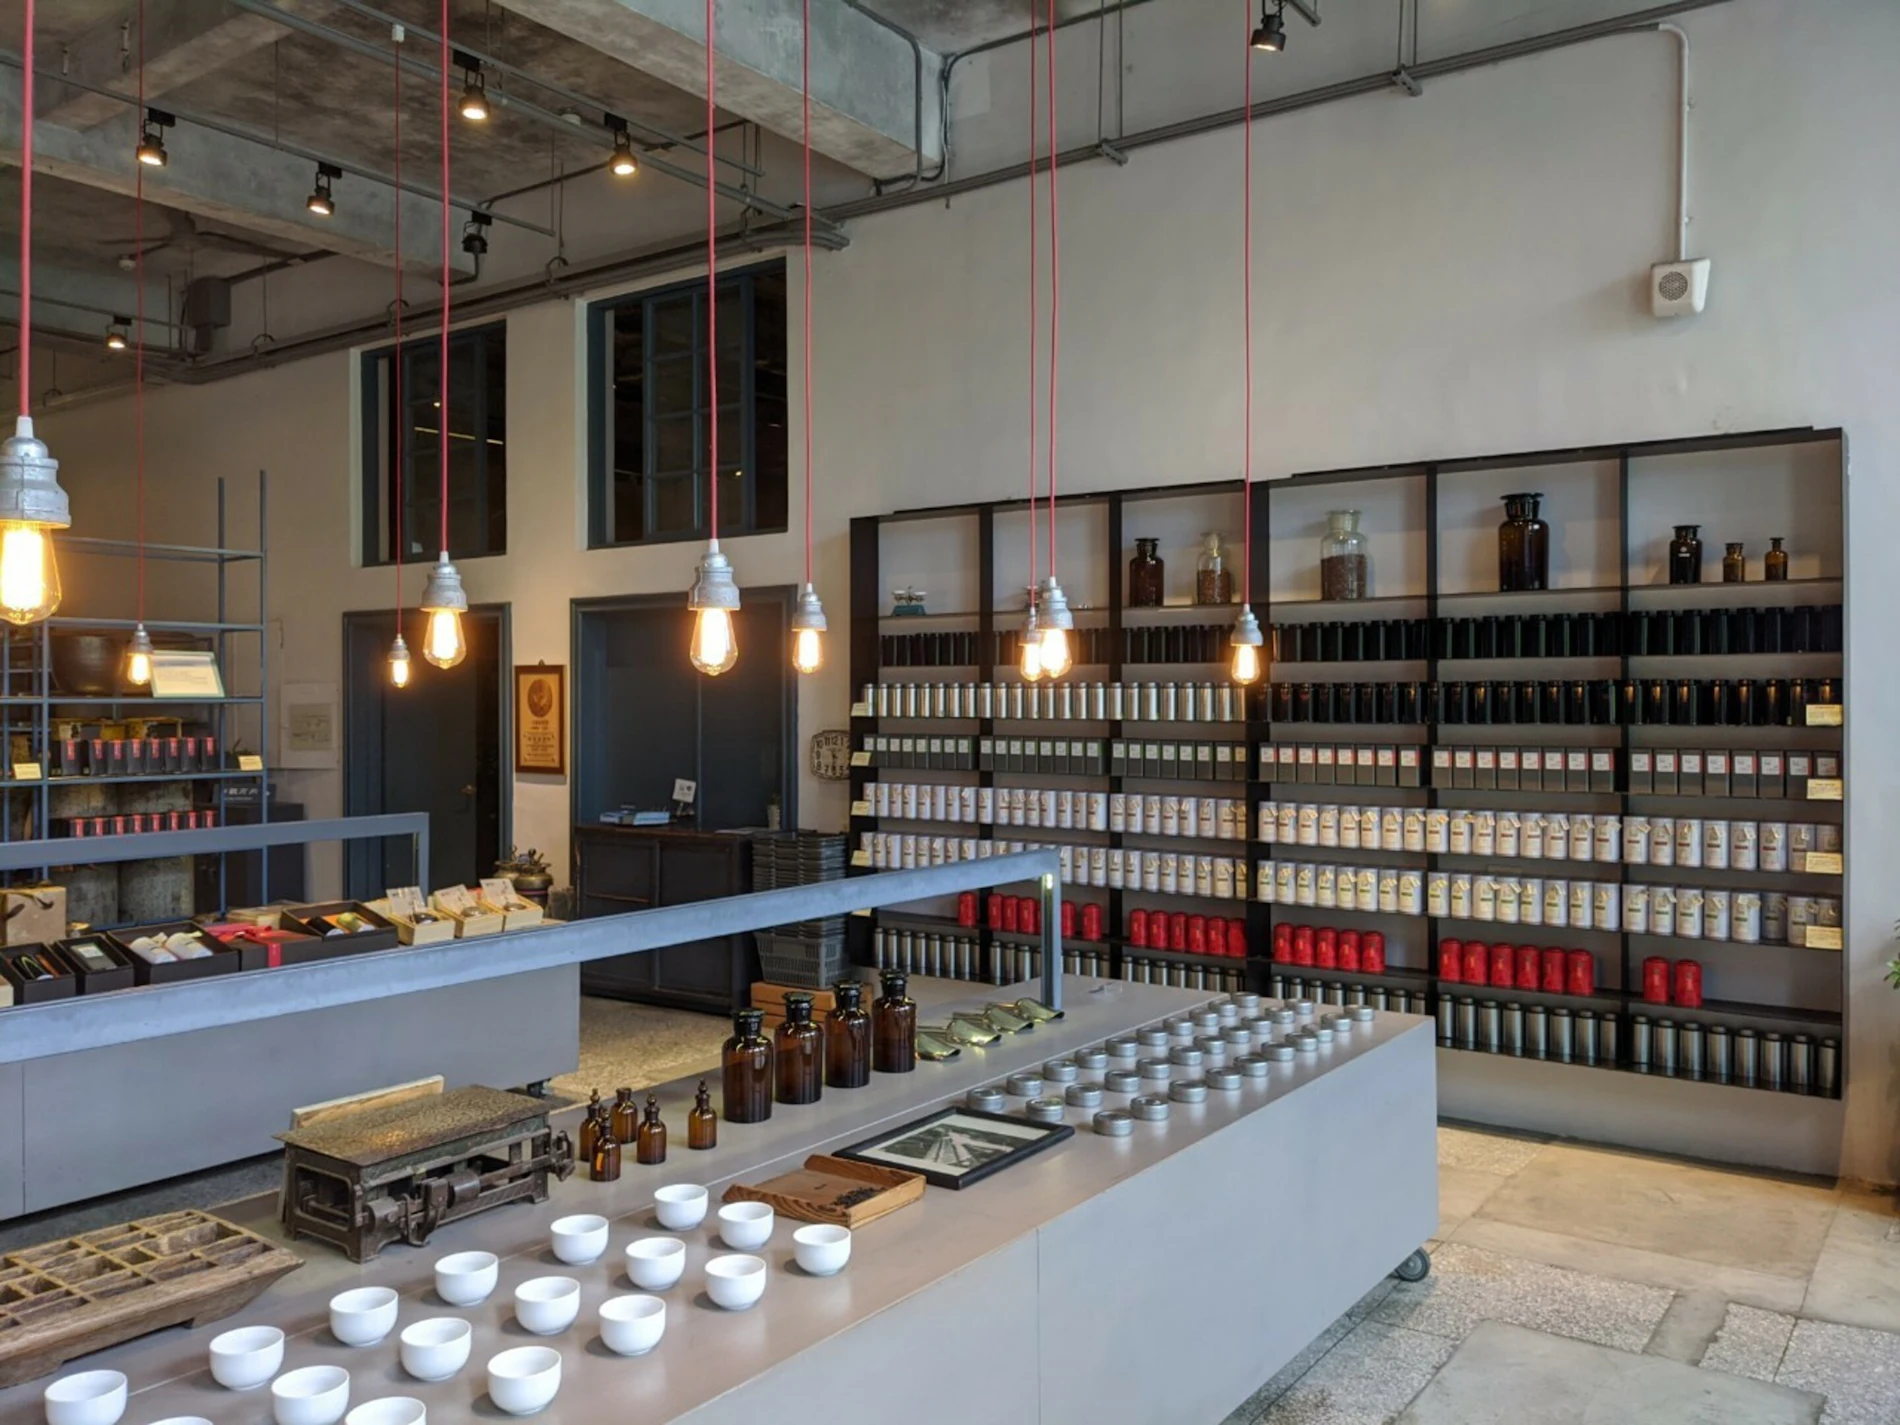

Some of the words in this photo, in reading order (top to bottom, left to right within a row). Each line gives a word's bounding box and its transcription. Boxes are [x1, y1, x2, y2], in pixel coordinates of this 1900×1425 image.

[824, 736, 830, 746] 11
[831, 735, 838, 746] 12
[816, 761, 821, 771] 8
